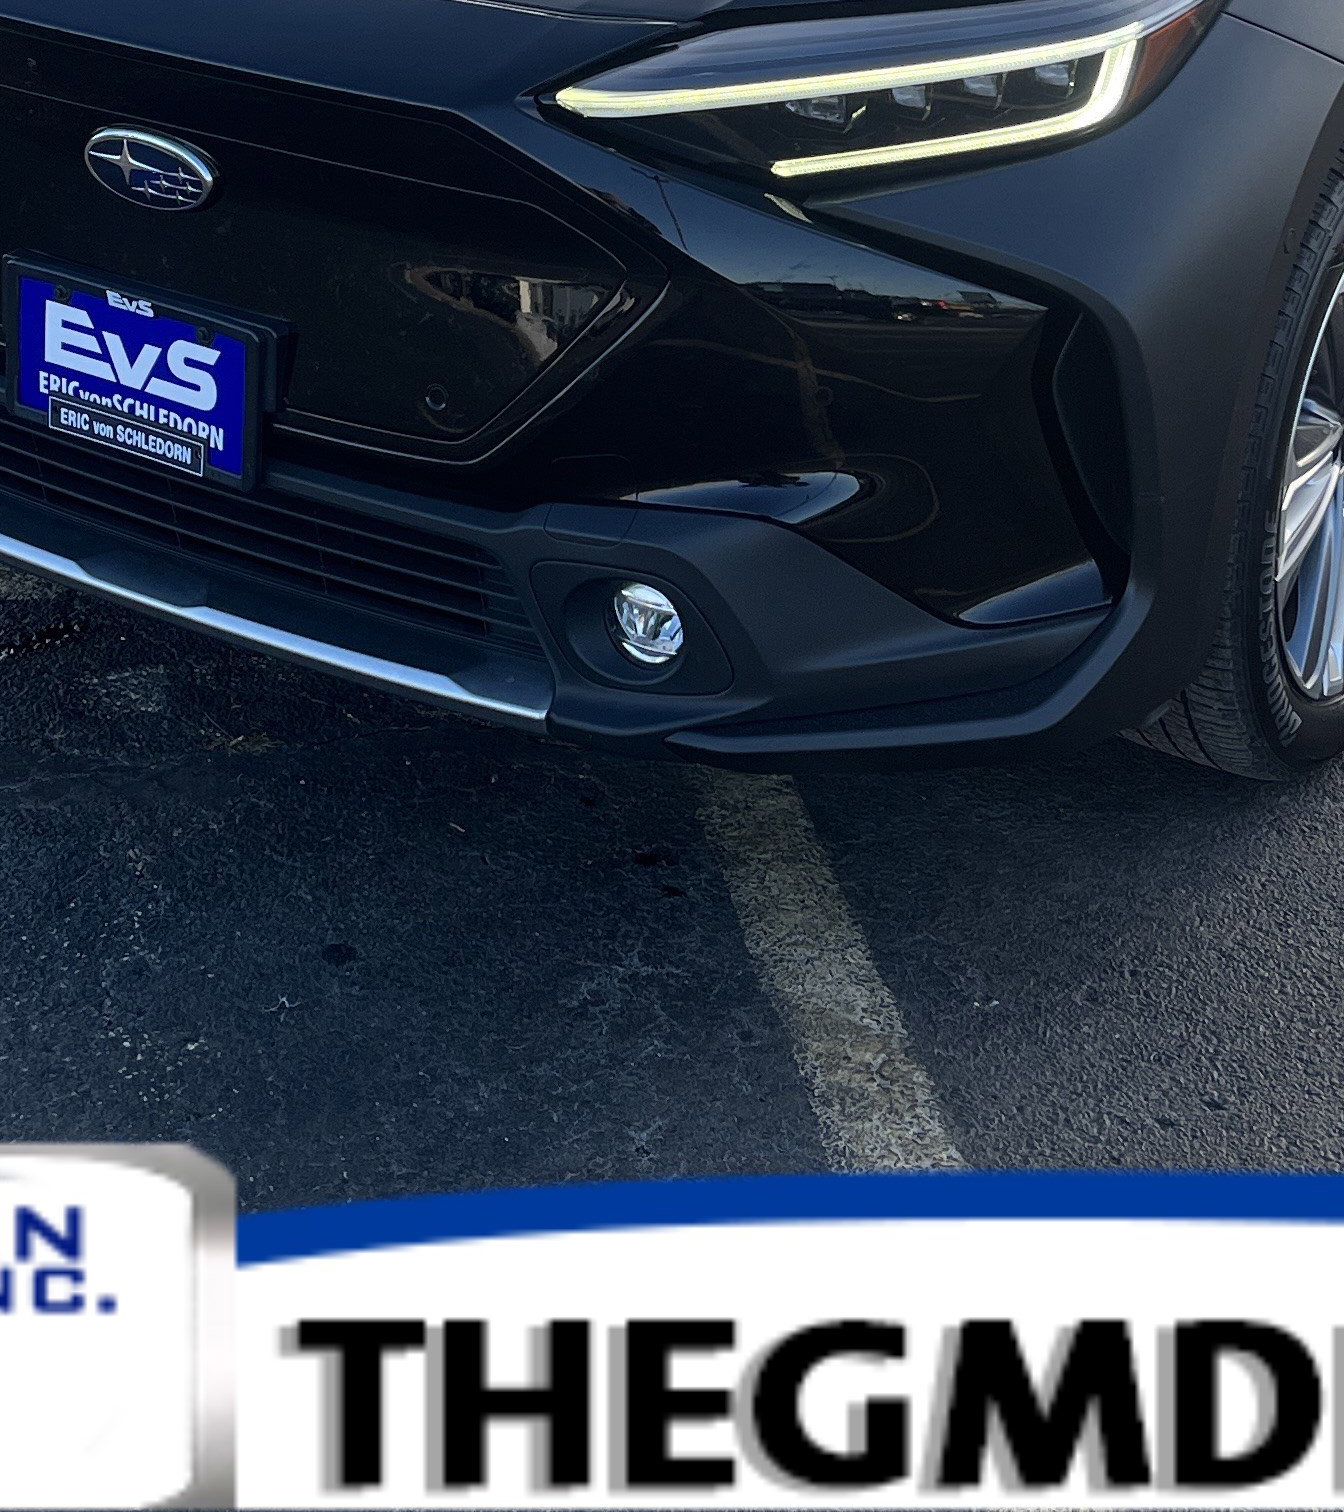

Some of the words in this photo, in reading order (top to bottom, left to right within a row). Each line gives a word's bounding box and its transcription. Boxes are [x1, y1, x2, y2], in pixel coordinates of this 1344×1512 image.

[39, 370, 79, 397] ERIC
[60, 407, 90, 431] ERIC
[93, 420, 114, 439] von
[116, 424, 192, 465] SCHLEDORN
